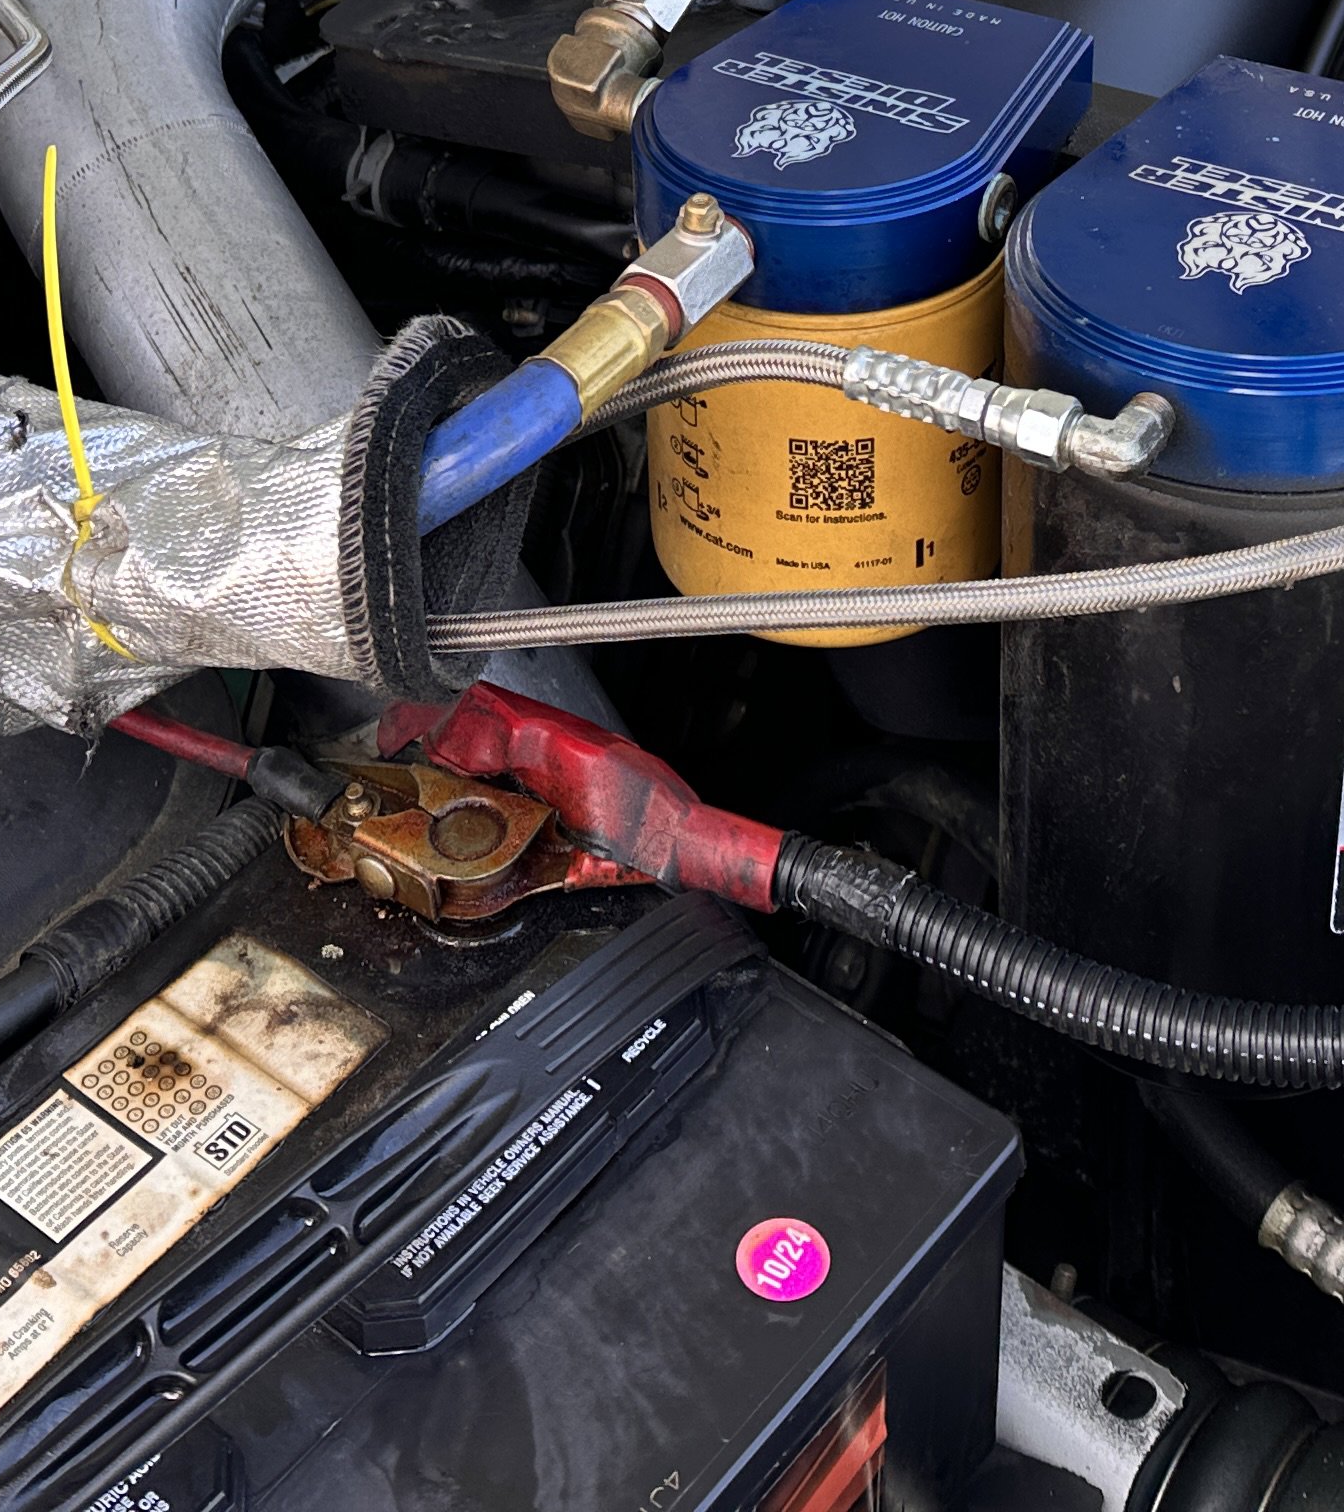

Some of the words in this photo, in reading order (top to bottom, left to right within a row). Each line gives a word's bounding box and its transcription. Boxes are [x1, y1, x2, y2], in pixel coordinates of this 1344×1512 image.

[877, 9, 907, 23] HOT
[907, 16, 964, 37] CAUTION
[713, 59, 970, 134] SINISTER
[755, 52, 956, 112] DIESEL
[1293, 106, 1326, 122] HOT
[776, 510, 802, 522] Scan
[806, 513, 820, 523] for
[679, 514, 754, 559] www.cat.com
[776, 557, 799, 568] Made
[811, 562, 831, 570] USA
[620, 1016, 667, 1063] RECYCLE
[20, 1123, 32, 1135] 65
[29, 1097, 63, 1127] WARNING
[155, 1125, 173, 1142] LIFT
[169, 1113, 186, 1129] OUT
[163, 1128, 183, 1147] YEAR
[180, 1116, 197, 1131] AND
[171, 1128, 198, 1153] MONTH
[195, 1092, 235, 1131] PURCHASED
[202, 1116, 252, 1165] STD
[392, 1202, 460, 1270] INSTRUCTIONS
[455, 1191, 472, 1208] IN
[467, 1155, 508, 1198] VEHICLE
[502, 1118, 544, 1163] OWNERS
[538, 1082, 581, 1126] MANUAL.
[400, 1263, 416, 1279] IF
[411, 1244, 436, 1270] NOT
[431, 1199, 483, 1250] AVAILABLE
[476, 1174, 506, 1205] SEEK
[499, 1140, 542, 1182] SERVICE
[535, 1088, 594, 1146] ASSISTANCE.
[107, 1221, 140, 1249] Reserve
[115, 1228, 150, 1258] Capacity
[757, 1227, 811, 1289] 10/24
[11, 1306, 50, 1343] Cranking
[4, 1334, 34, 1362] Amps
[26, 1327, 41, 1341] at
[138, 1491, 160, 1511] OR
